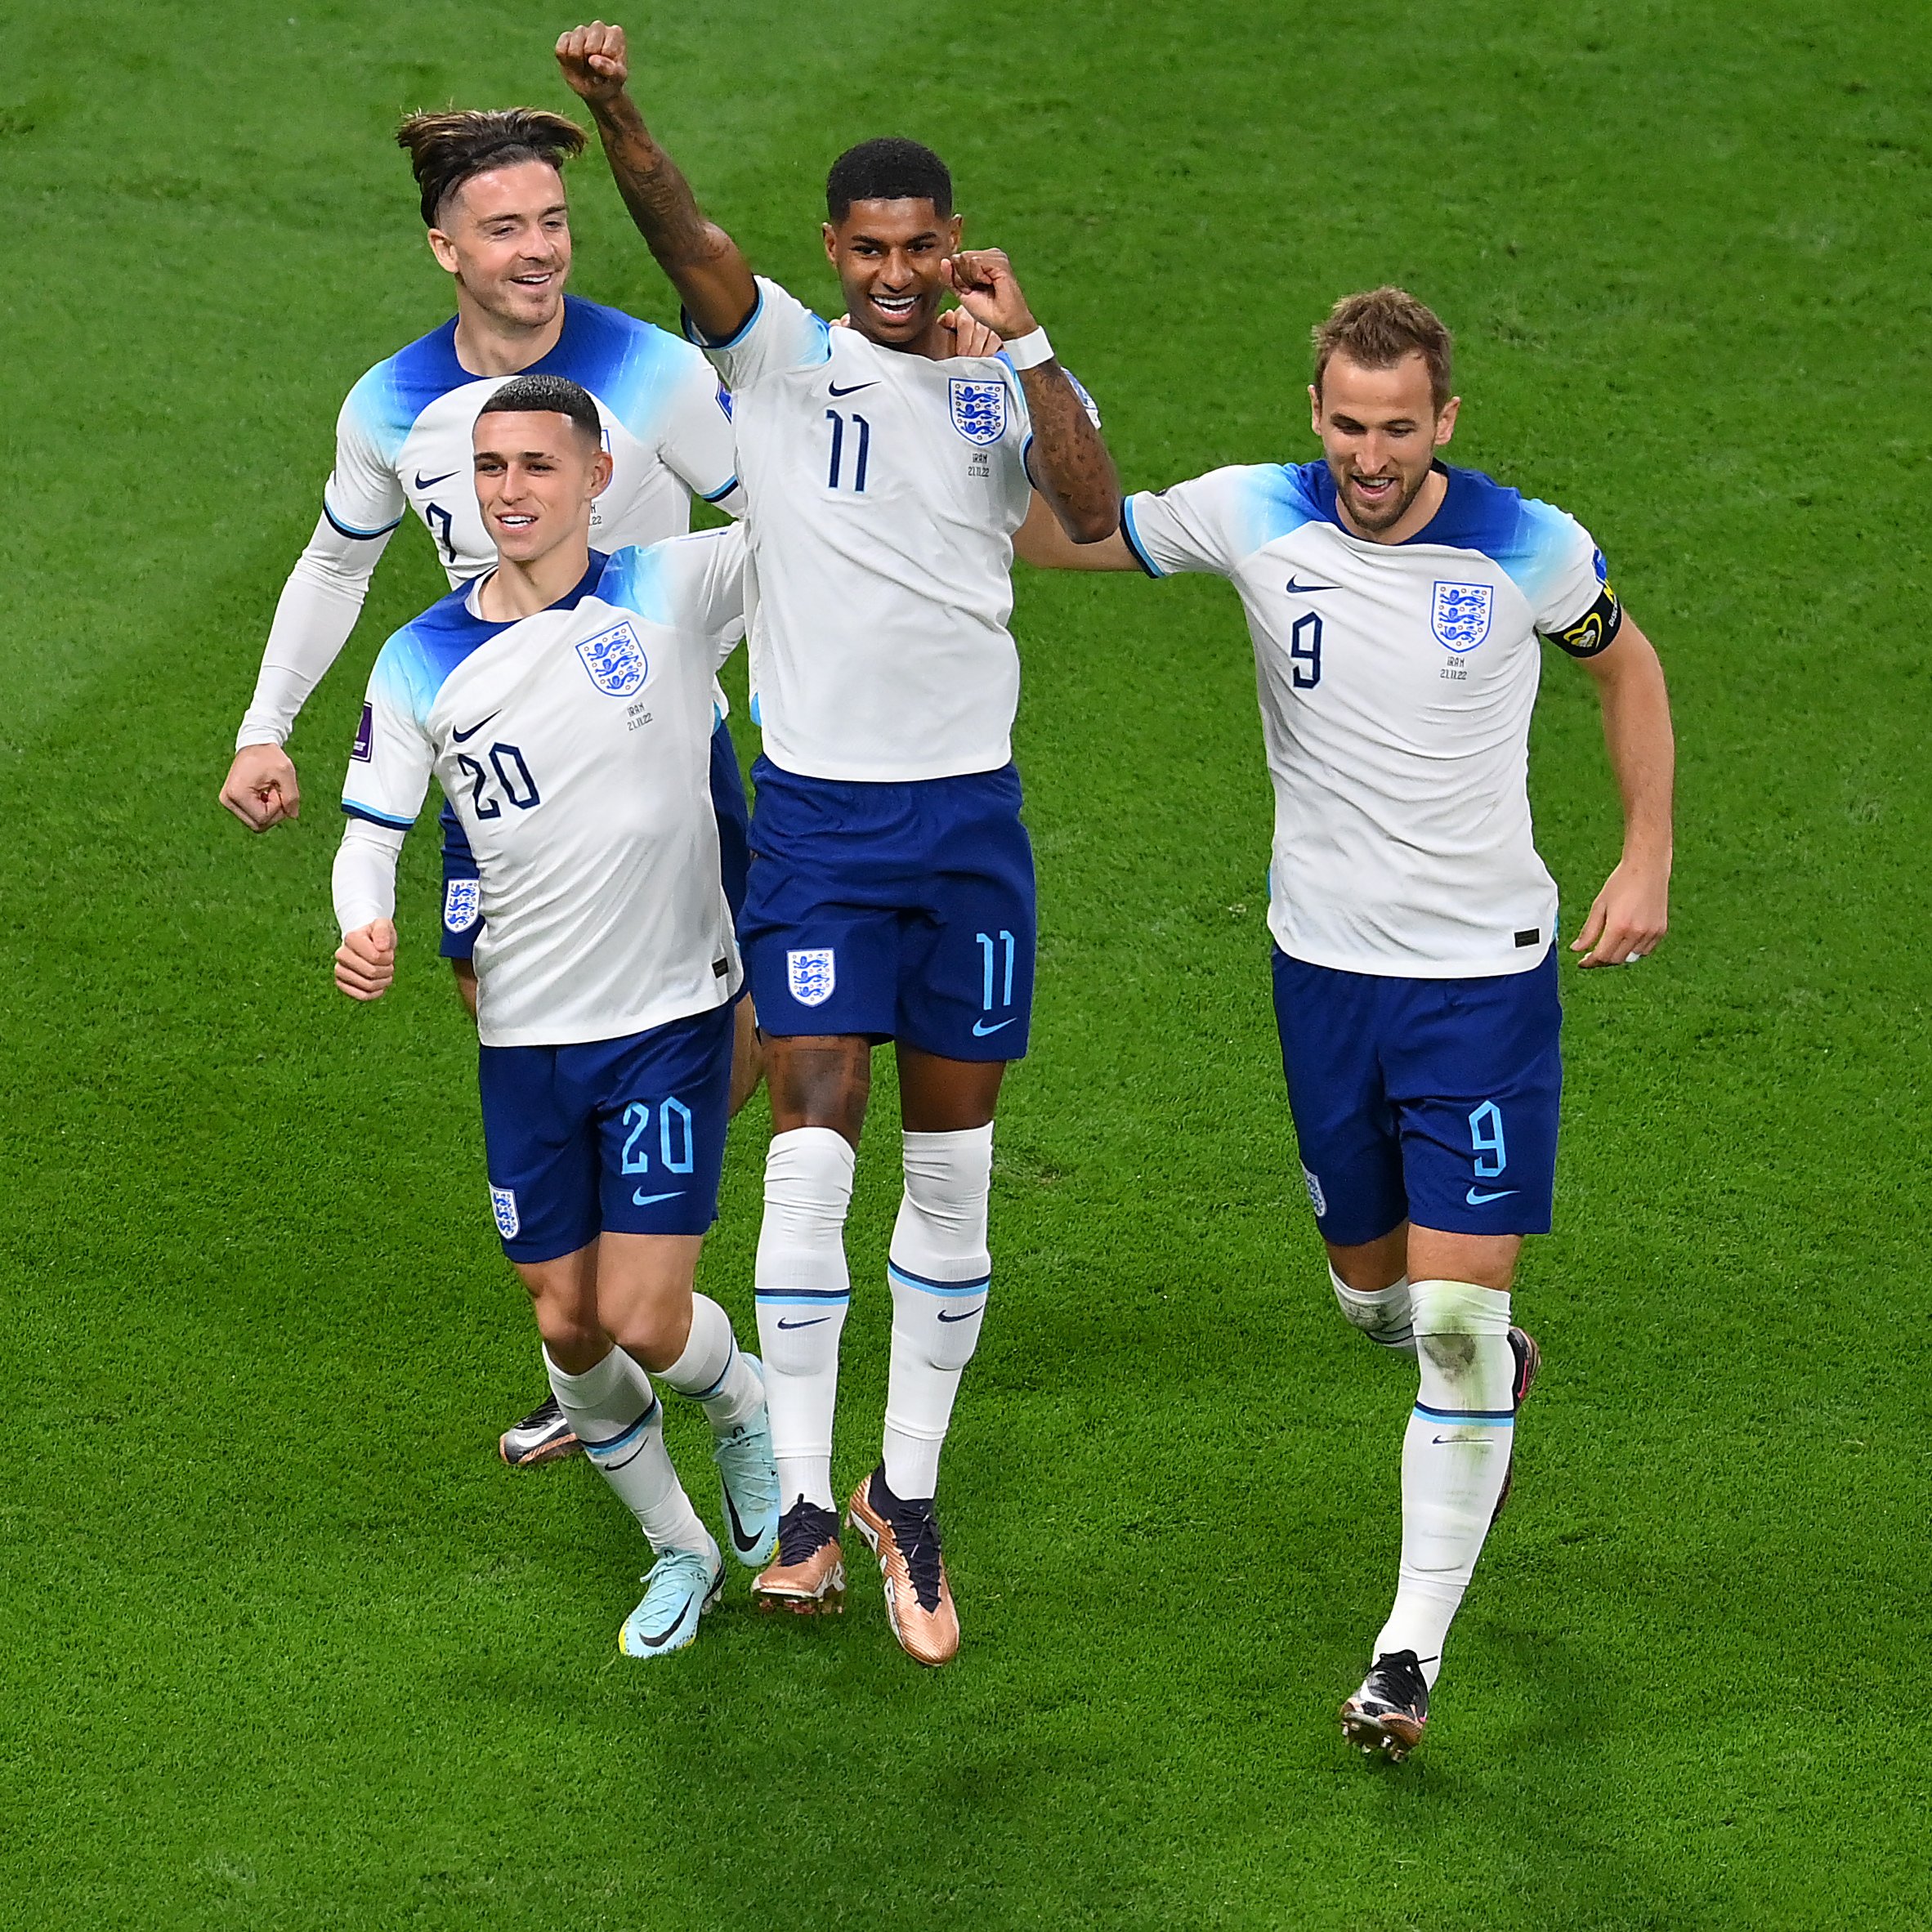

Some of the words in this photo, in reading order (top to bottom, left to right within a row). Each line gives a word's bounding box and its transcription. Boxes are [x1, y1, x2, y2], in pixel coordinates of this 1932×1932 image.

[825, 409, 870, 492] 11
[426, 502, 457, 563] 7
[1290, 610, 1323, 689] 9
[458, 742, 540, 821] 20
[976, 930, 1014, 1010] 11
[621, 1096, 693, 1174] 20
[1469, 1100, 1506, 1177] 9
